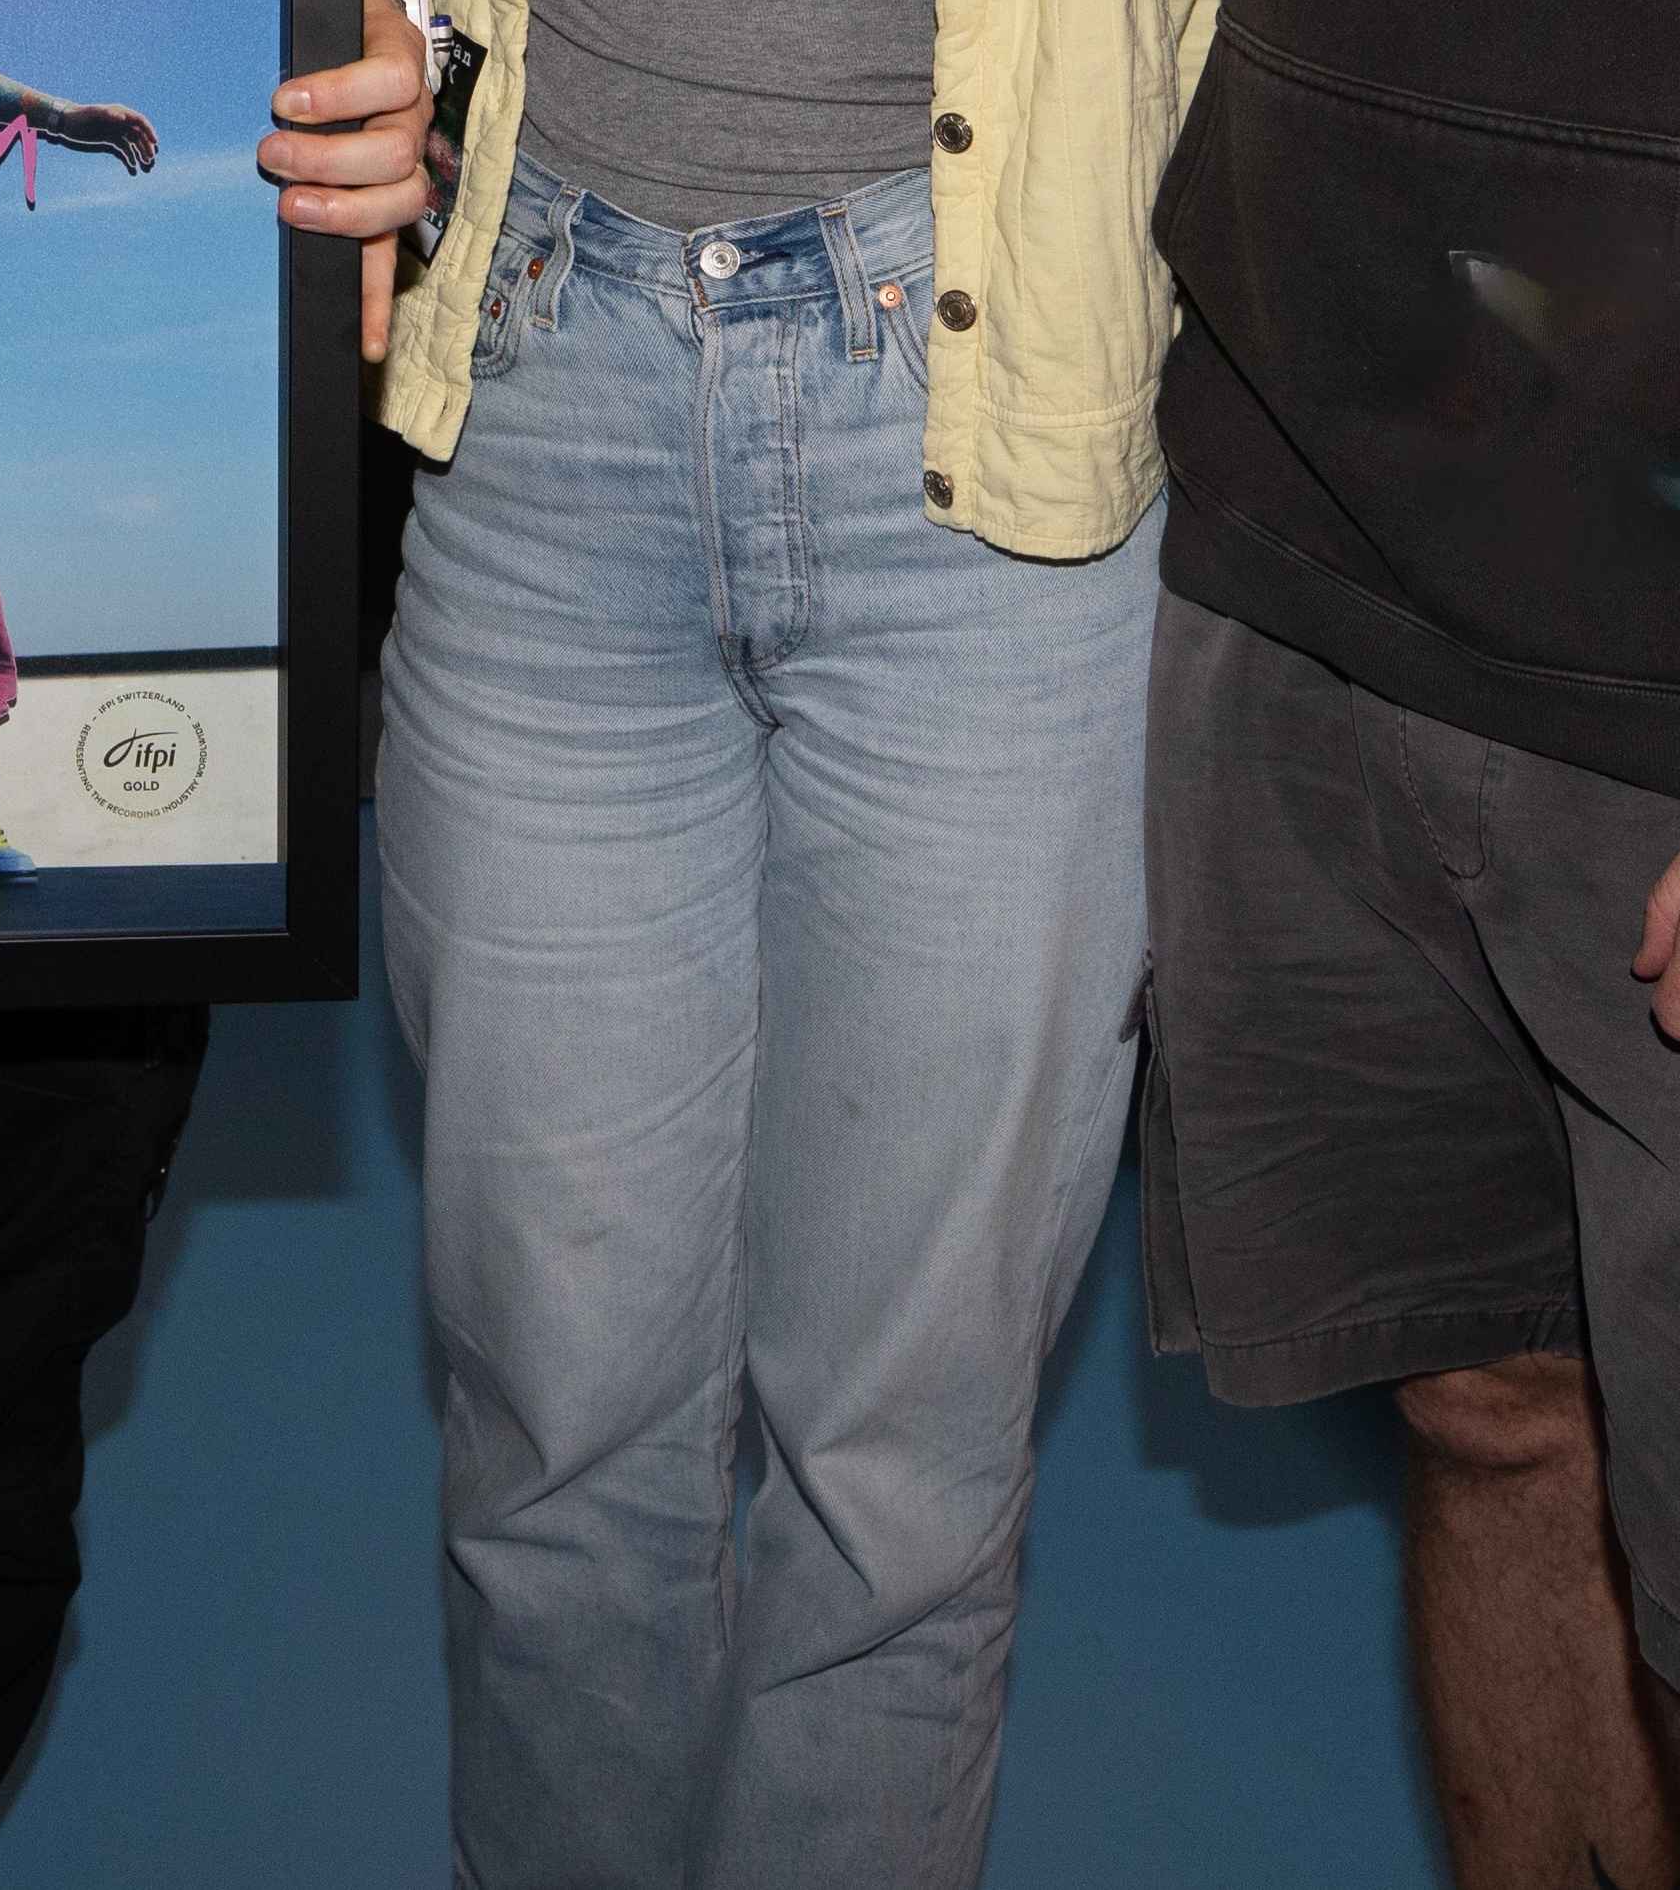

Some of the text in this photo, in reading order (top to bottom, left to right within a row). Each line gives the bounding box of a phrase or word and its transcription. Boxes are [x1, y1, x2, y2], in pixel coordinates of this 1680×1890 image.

[98, 691, 185, 714] IFPI SWITZERLAND
[76, 724, 93, 792] REPRESENTING
[91, 790, 106, 807] THE
[107, 803, 160, 819] RECORDING
[161, 779, 200, 814] INDUSTRY
[135, 742, 177, 774] ifpi
[123, 781, 160, 792] GOLD
